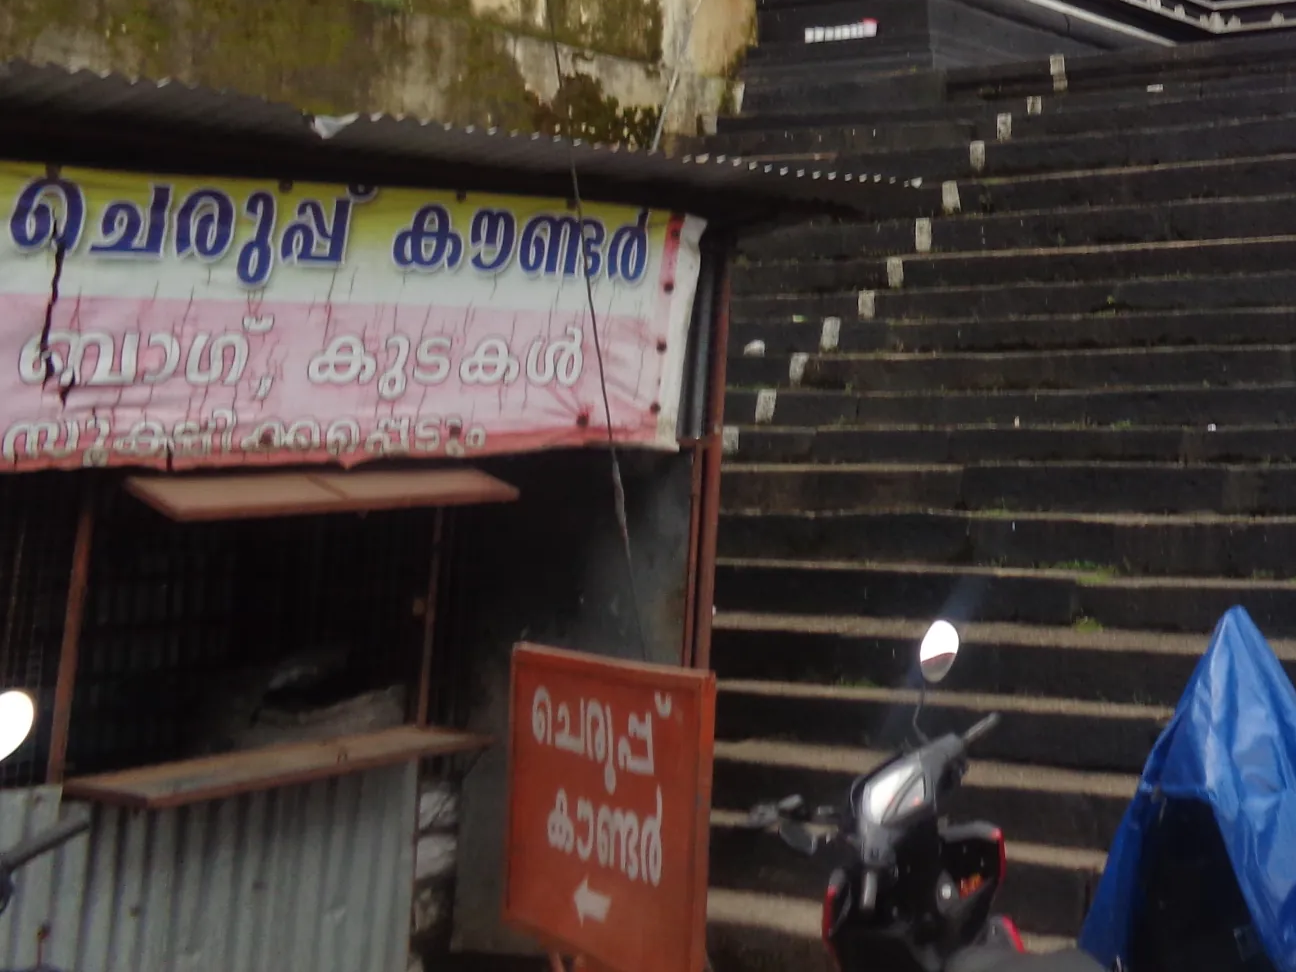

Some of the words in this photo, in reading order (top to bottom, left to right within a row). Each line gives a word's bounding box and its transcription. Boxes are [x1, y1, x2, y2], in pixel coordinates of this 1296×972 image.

[9, 179, 377, 285] ചെരുപ്പ്
[393, 203, 650, 284] കൗണ്ടർ
[307, 326, 584, 400] കുടകൾ
[532, 685, 672, 795] ചെരുപ്പ്
